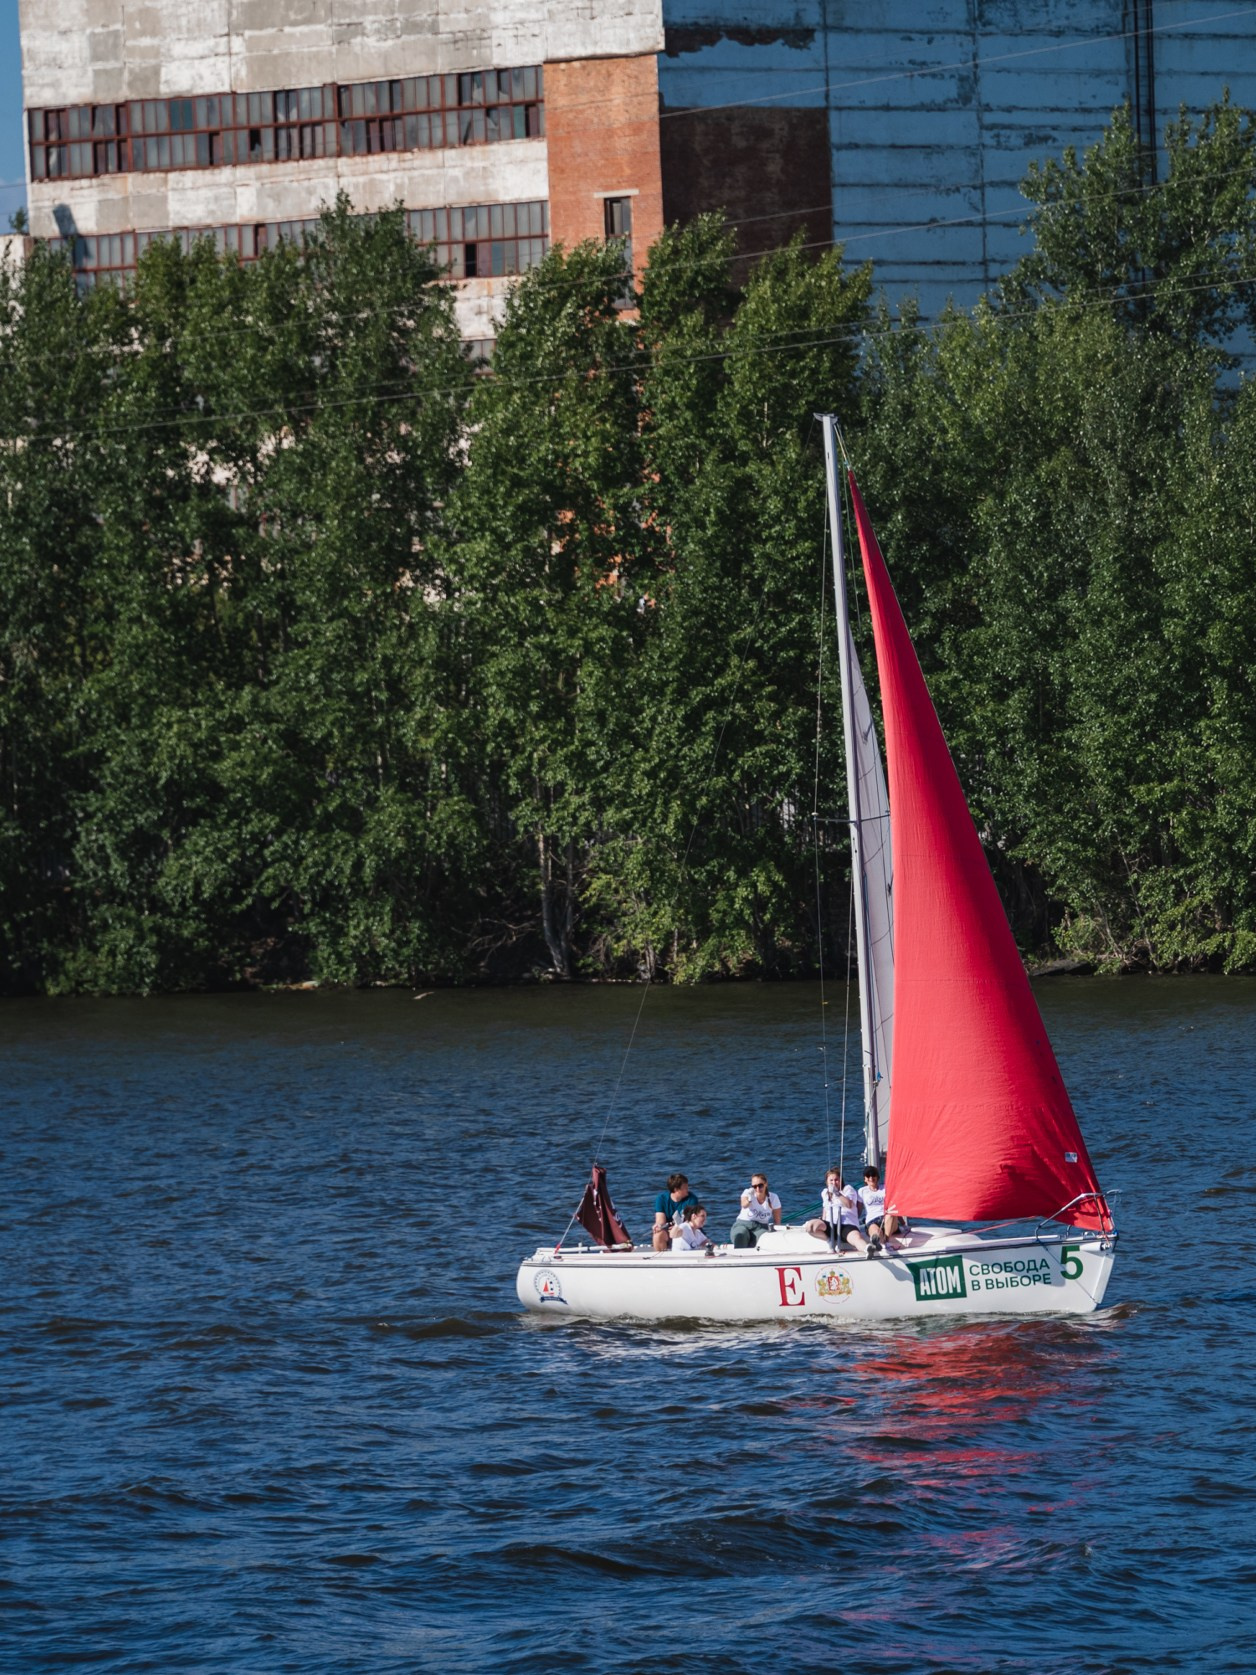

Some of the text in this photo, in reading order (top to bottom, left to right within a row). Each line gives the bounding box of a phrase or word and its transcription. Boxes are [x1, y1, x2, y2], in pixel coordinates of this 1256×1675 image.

[969, 1258, 1050, 1276] СВОБОДА
[1060, 1245, 1083, 1280] 5
[919, 1265, 962, 1296] АТОМ
[971, 1273, 1051, 1291] В ВЫБОРЕ
